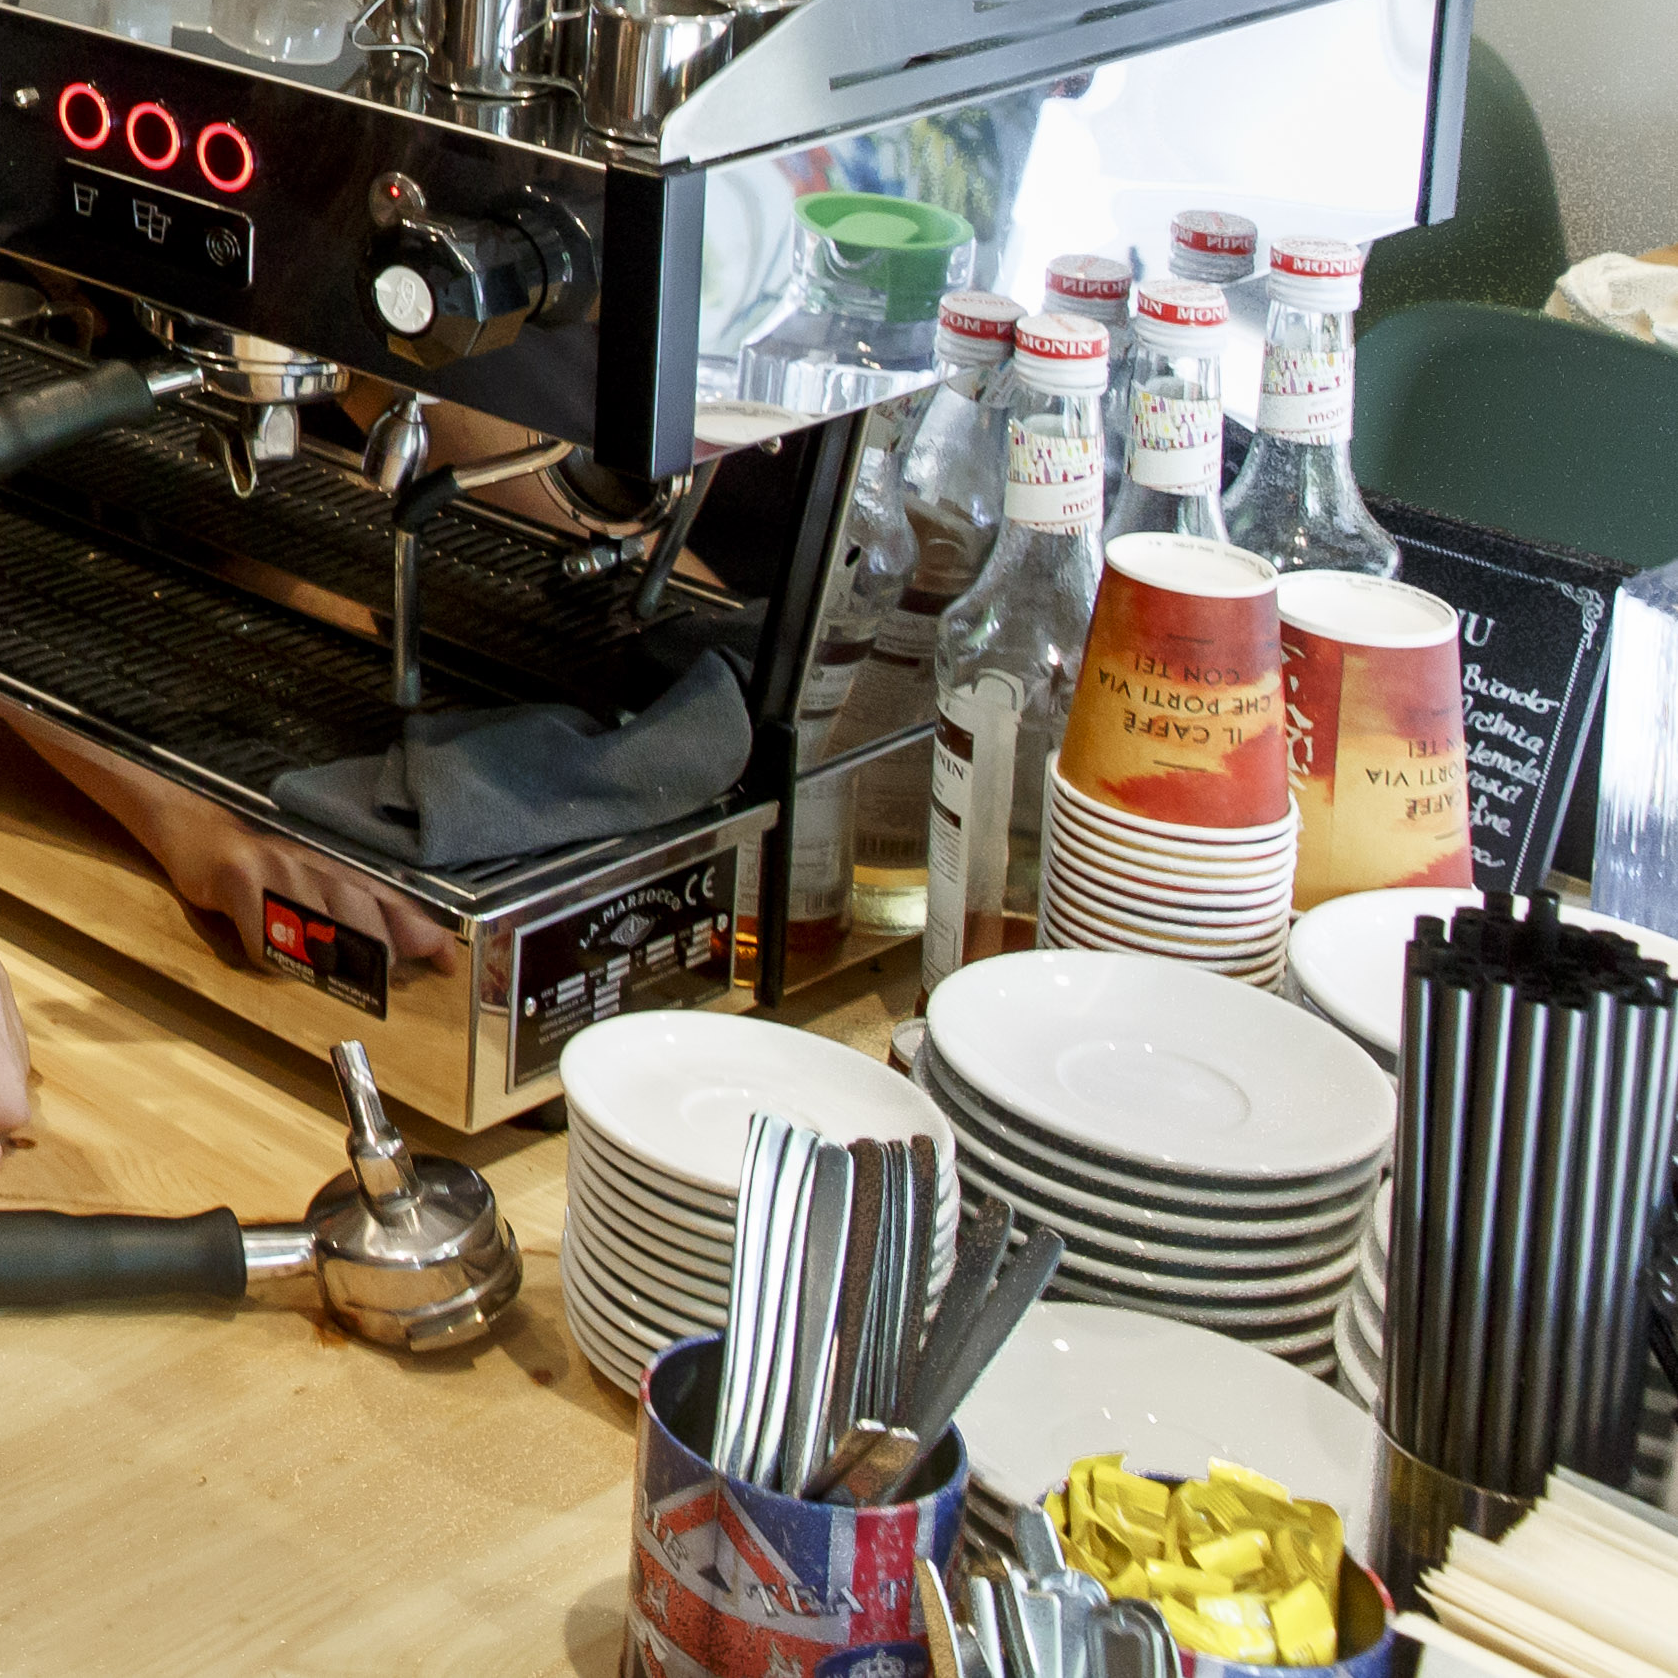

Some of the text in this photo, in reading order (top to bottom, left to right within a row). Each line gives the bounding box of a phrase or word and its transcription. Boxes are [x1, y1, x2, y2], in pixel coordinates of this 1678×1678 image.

[1293, 255, 1362, 275] MONIN
[1021, 332, 1094, 356] MONIN
[1183, 664, 1241, 686] CON
[1098, 666, 1272, 716] CHE PORTI VIA
[1222, 726, 1243, 745] IL
[1365, 767, 1410, 788] VIA
[579, 888, 682, 949] LA MARZOCCO
